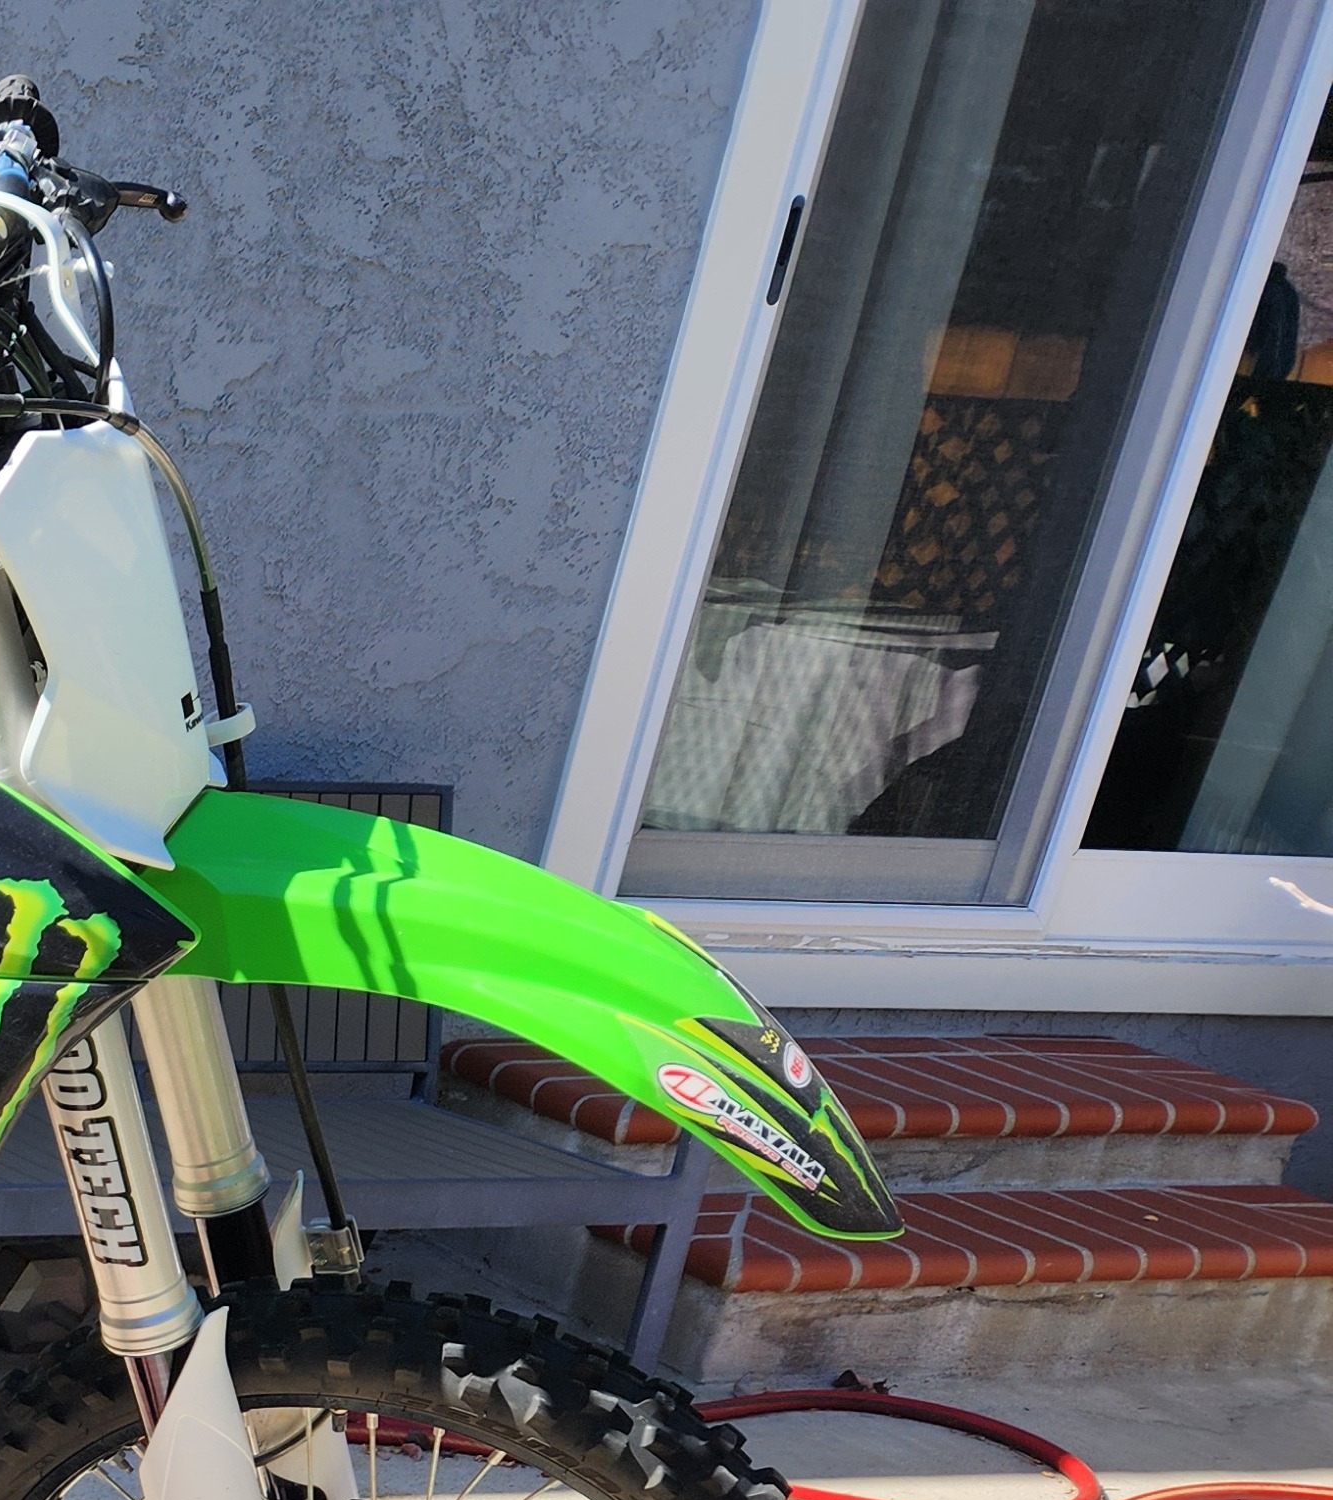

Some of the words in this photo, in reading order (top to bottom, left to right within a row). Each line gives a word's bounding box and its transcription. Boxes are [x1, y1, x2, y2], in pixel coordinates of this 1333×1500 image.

[709, 1096, 826, 1185] MAXIMA
[716, 1116, 781, 1163] RACING
[780, 1158, 818, 1192] OILS
[60, 1117, 148, 1267] TECH
